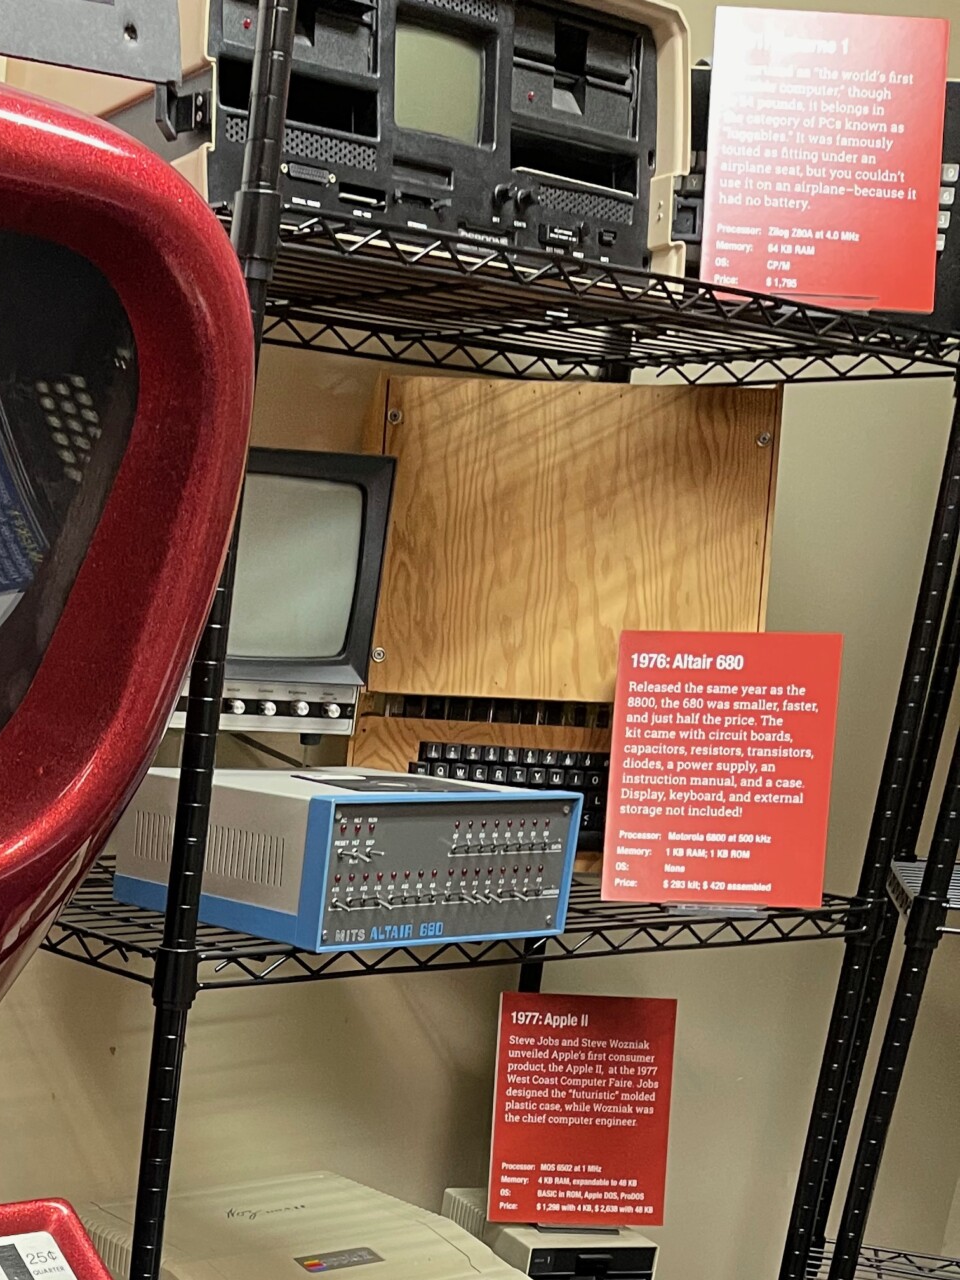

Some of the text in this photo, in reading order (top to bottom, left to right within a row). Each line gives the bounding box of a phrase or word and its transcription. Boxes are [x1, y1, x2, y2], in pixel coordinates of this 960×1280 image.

[720, 161, 772, 175] airplane
[775, 165, 803, 178] seat,
[806, 167, 826, 178] but
[828, 170, 852, 182] you
[720, 180, 742, 190] use
[744, 179, 754, 190] it
[756, 182, 772, 190] on
[775, 182, 791, 192] an
[908, 188, 917, 200] it
[719, 194, 811, 210] had no battery.
[631, 652, 744, 670] 1976: Altair 680
[629, 681, 806, 696] Released the same year as the
[627, 696, 818, 712] 8800, the 680 was smaller, faster,
[626, 712, 783, 727] and just half the price. The
[334, 928, 366, 942] MITS
[370, 924, 413, 940] ALTAIR
[511, 1011, 588, 1028] 1977: Apple II
[509, 1035, 649, 1049] Steve Jobs and Steve Wozniak
[508, 1048, 548, 1058] unveiled
[587, 1050, 606, 1060] first
[608, 1054, 654, 1062] consumer
[507, 1061, 657, 1075] product, the Apple II, at the 1977
[26, 1250, 58, 1265] 25¢
[33, 1266, 66, 1276] QUARTER
